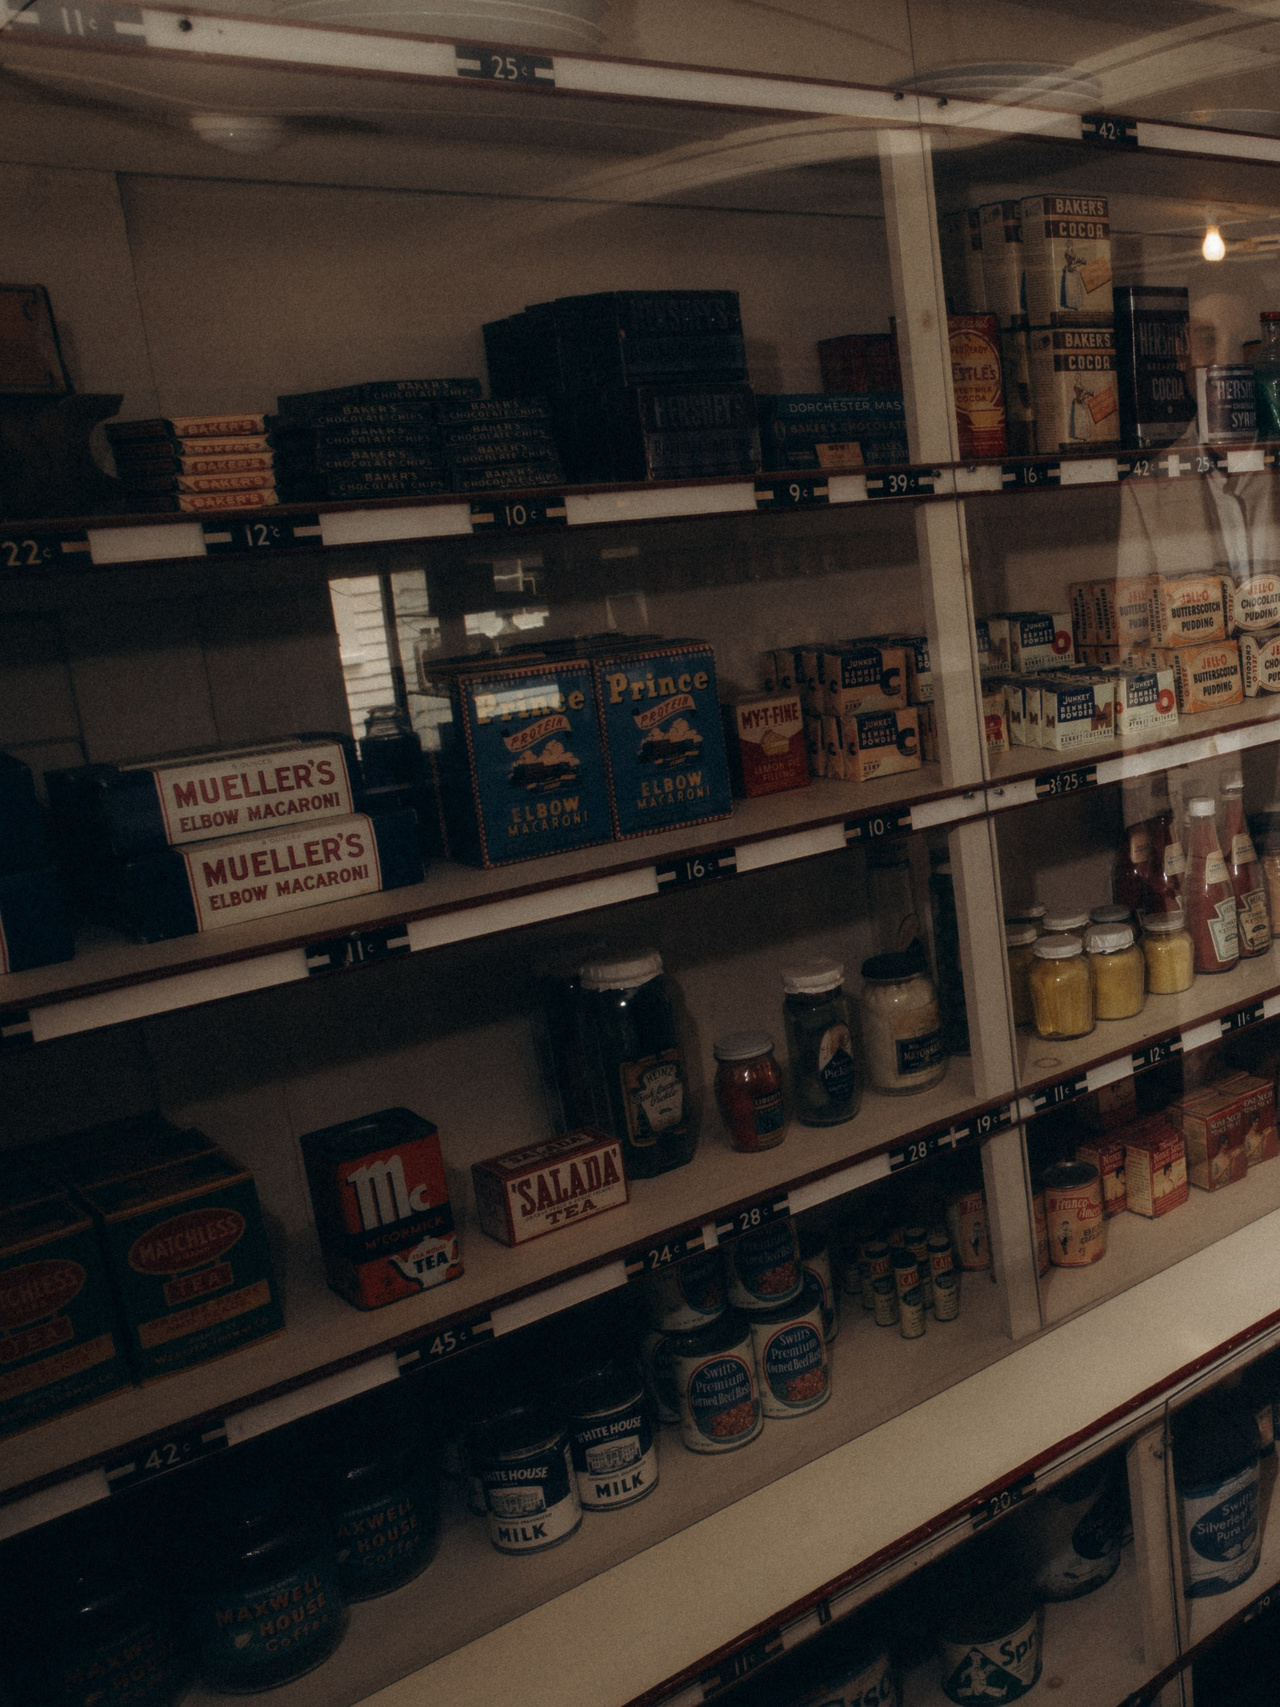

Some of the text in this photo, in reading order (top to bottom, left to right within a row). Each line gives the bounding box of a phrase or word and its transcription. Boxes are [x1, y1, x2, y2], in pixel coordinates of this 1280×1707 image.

[1055, 199, 1105, 216] BAKER'S
[1059, 222, 1104, 238] COCOA
[1065, 332, 1111, 348] BAKER'S
[1068, 355, 1111, 370] COCOA
[1171, 601, 1221, 619] BUTTERSCOTCH
[1244, 606, 1279, 622] PUDDING
[1181, 617, 1214, 632] PUDDING
[1201, 653, 1228, 669] JELL-O
[1193, 665, 1238, 684] BUTTERSCOTCH
[606, 671, 710, 704] Prince
[1203, 680, 1233, 697] PUDDING
[640, 695, 690, 728] PROTEIN
[741, 702, 799, 729] MY-T-FINE
[511, 717, 564, 747] PROTEIN
[171, 758, 336, 809] MUELLER'S
[642, 771, 703, 797] ELBOW
[513, 796, 580, 823] ELBOW
[637, 783, 710, 811] MACARONI
[180, 792, 342, 833] ELBOW MACARONI
[508, 811, 588, 837] MACARONI
[201, 832, 366, 887] MUELLER'S
[209, 864, 370, 911] ELBOW MACARONI
[646, 1066, 674, 1084] HEINZ
[346, 1154, 431, 1231] Mc
[546, 1199, 598, 1226] TEA
[1078, 1206, 1100, 1219] Amer
[139, 1215, 237, 1260] MATCHLESS
[413, 1251, 450, 1275] TEA
[771, 1338, 818, 1360] Premium
[779, 1328, 812, 1347] Swift's
[704, 1359, 737, 1380] Swift's
[695, 1373, 746, 1394] Premium
[610, 1415, 642, 1435] HOUSE
[508, 1466, 549, 1482] HOUSE
[595, 1470, 645, 1500] MILK
[357, 1514, 419, 1553] HOUSE
[498, 1522, 548, 1544] MILK
[215, 1575, 322, 1628] MAXWELL
[260, 1593, 326, 1636] HOUSE
[999, 1630, 1036, 1667] Spr
